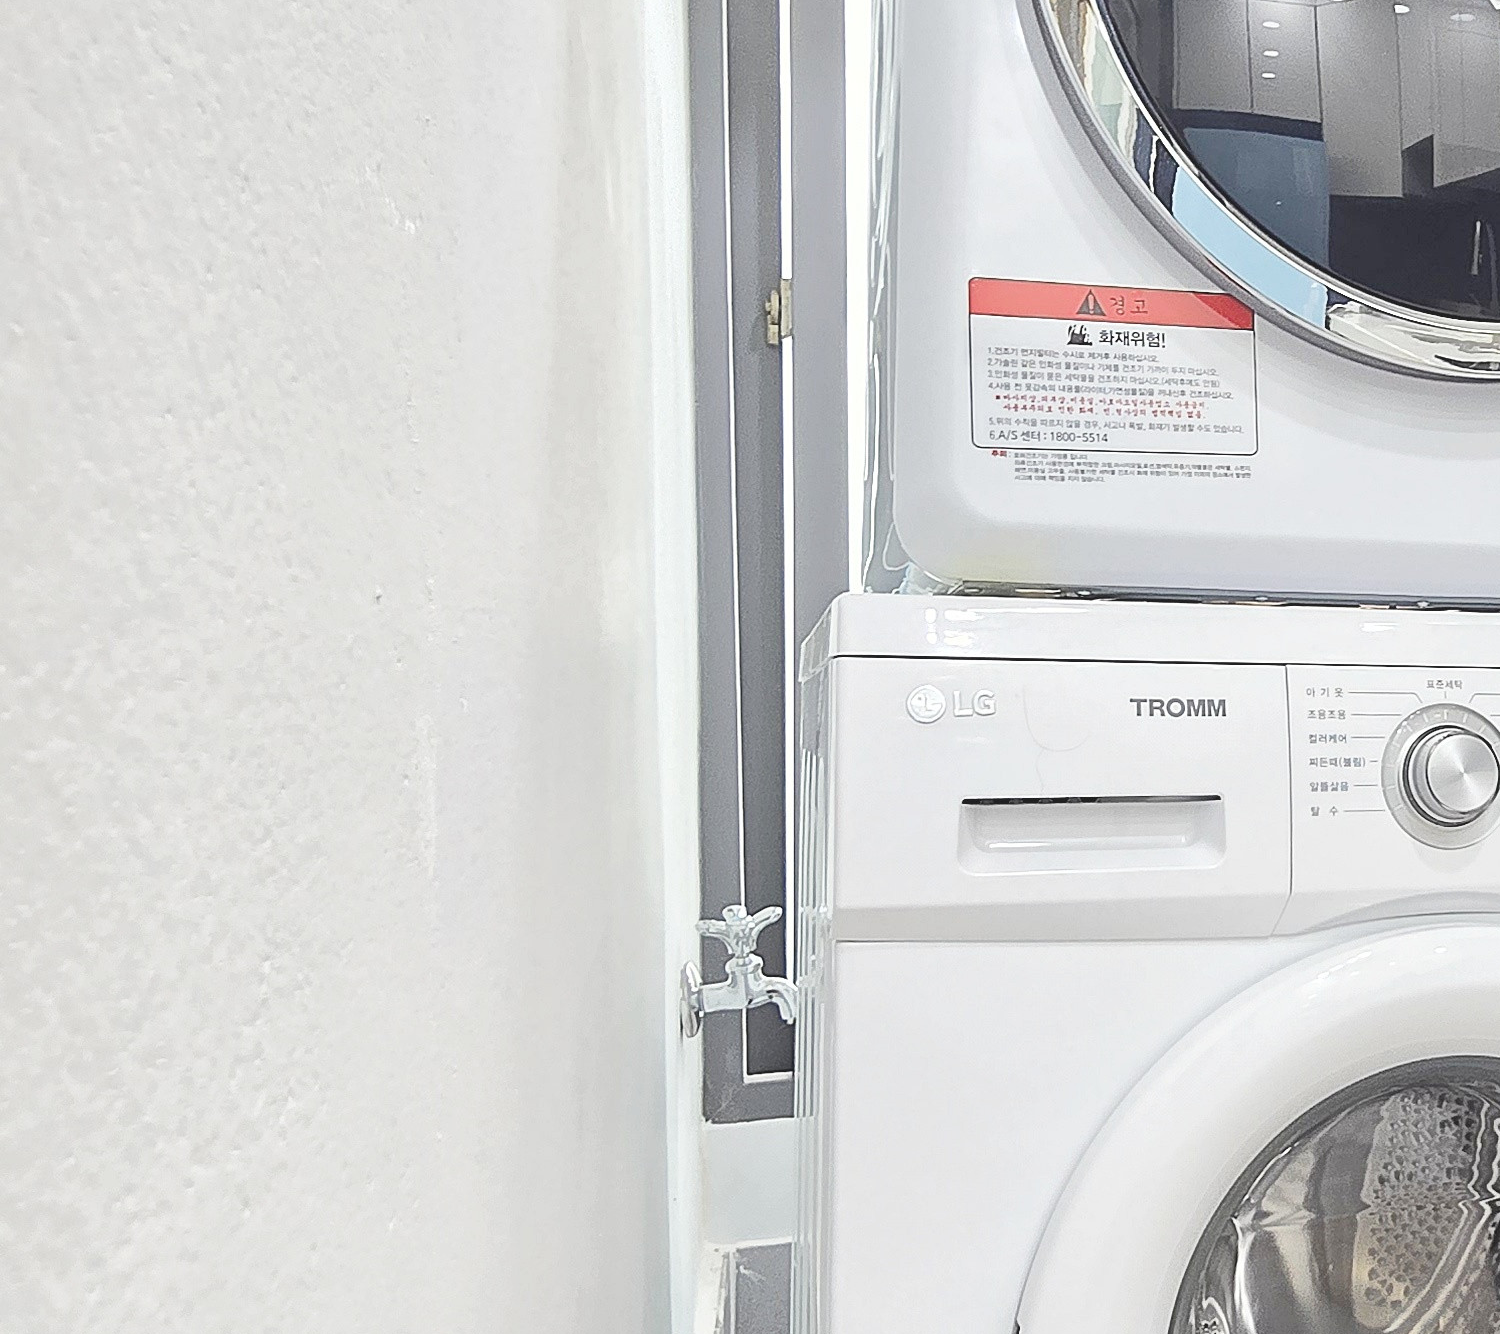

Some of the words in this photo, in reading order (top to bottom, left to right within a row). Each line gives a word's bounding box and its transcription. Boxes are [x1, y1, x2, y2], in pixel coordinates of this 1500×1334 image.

[1109, 295, 1149, 315] 경고
[1098, 329, 1166, 349] 화재위험!
[1062, 350, 1085, 359] 수시로
[1088, 351, 1111, 360] 제거후
[1039, 360, 1061, 369] 인화성
[1122, 364, 1144, 373] 건조기
[1147, 365, 1169, 374] 가까이
[1171, 366, 1186, 375] 두지
[1098, 375, 1128, 384] 건조하지
[1040, 419, 1064, 428] 따르지
[1066, 419, 1081, 429] 않을
[1103, 421, 1126, 430] 사고나
[1148, 422, 1170, 432] 화재가
[1173, 423, 1195, 433] 발생할
[1196, 423, 1211, 433] 수도
[1020, 431, 1041, 442] 센터
[1050, 431, 1109, 443] 1800-5514
[1426, 679, 1463, 690] 표준세탁
[952, 690, 997, 718] LG
[1129, 697, 1227, 718] TROMM
[1307, 709, 1346, 720] 조용조용
[1309, 733, 1347, 744] 컬러케어
[1310, 781, 1349, 792] 알뜰삶음
